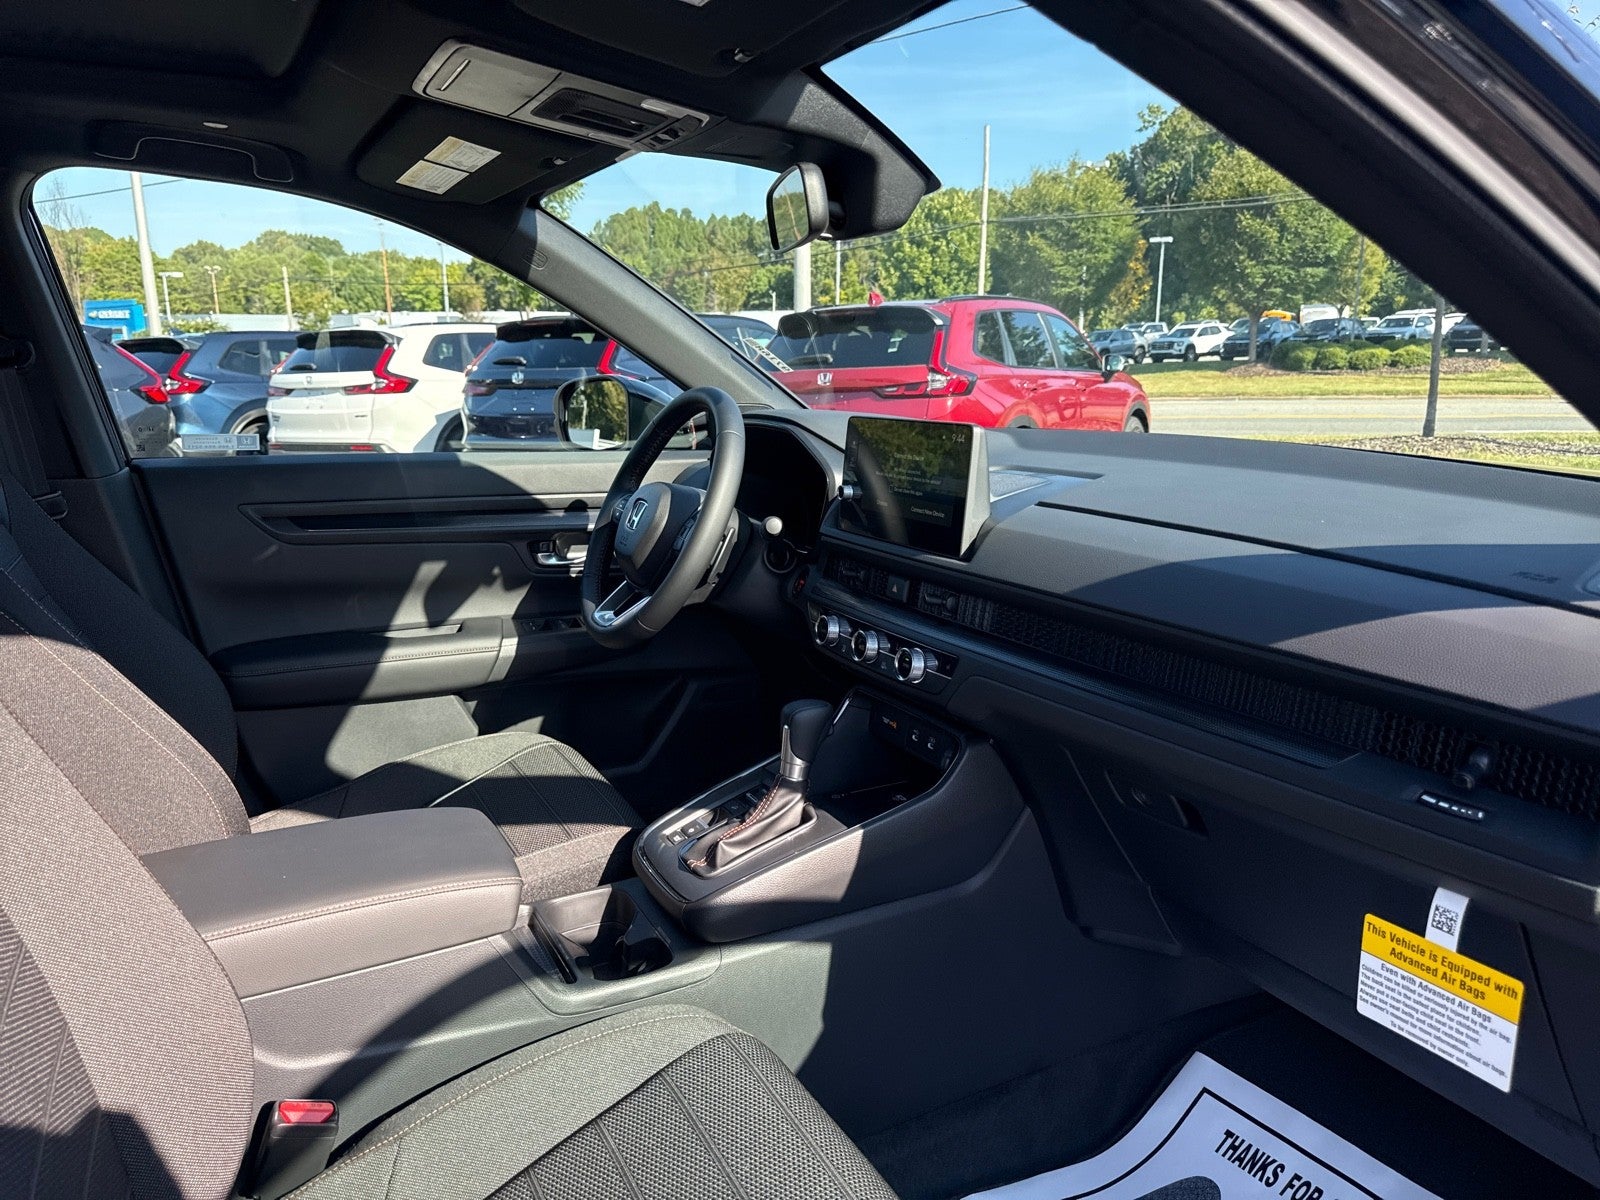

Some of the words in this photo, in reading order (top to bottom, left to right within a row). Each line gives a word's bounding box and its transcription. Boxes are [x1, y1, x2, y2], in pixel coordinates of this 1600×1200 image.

[1366, 921, 1386, 939] This
[1389, 931, 1426, 957] Vehicle
[1429, 949, 1438, 963] is
[1440, 955, 1490, 987] Equipped
[1493, 980, 1517, 999] with
[1389, 946, 1437, 977] Advanced
[1440, 970, 1456, 987] Air
[1459, 978, 1486, 1001] Bags
[1380, 962, 1398, 977] Even
[1400, 973, 1416, 986] with
[1417, 980, 1455, 1005] Advanced
[1457, 999, 1469, 1012] Air
[1471, 1006, 1491, 1024] Bags
[1215, 1129, 1286, 1188] THANKS
